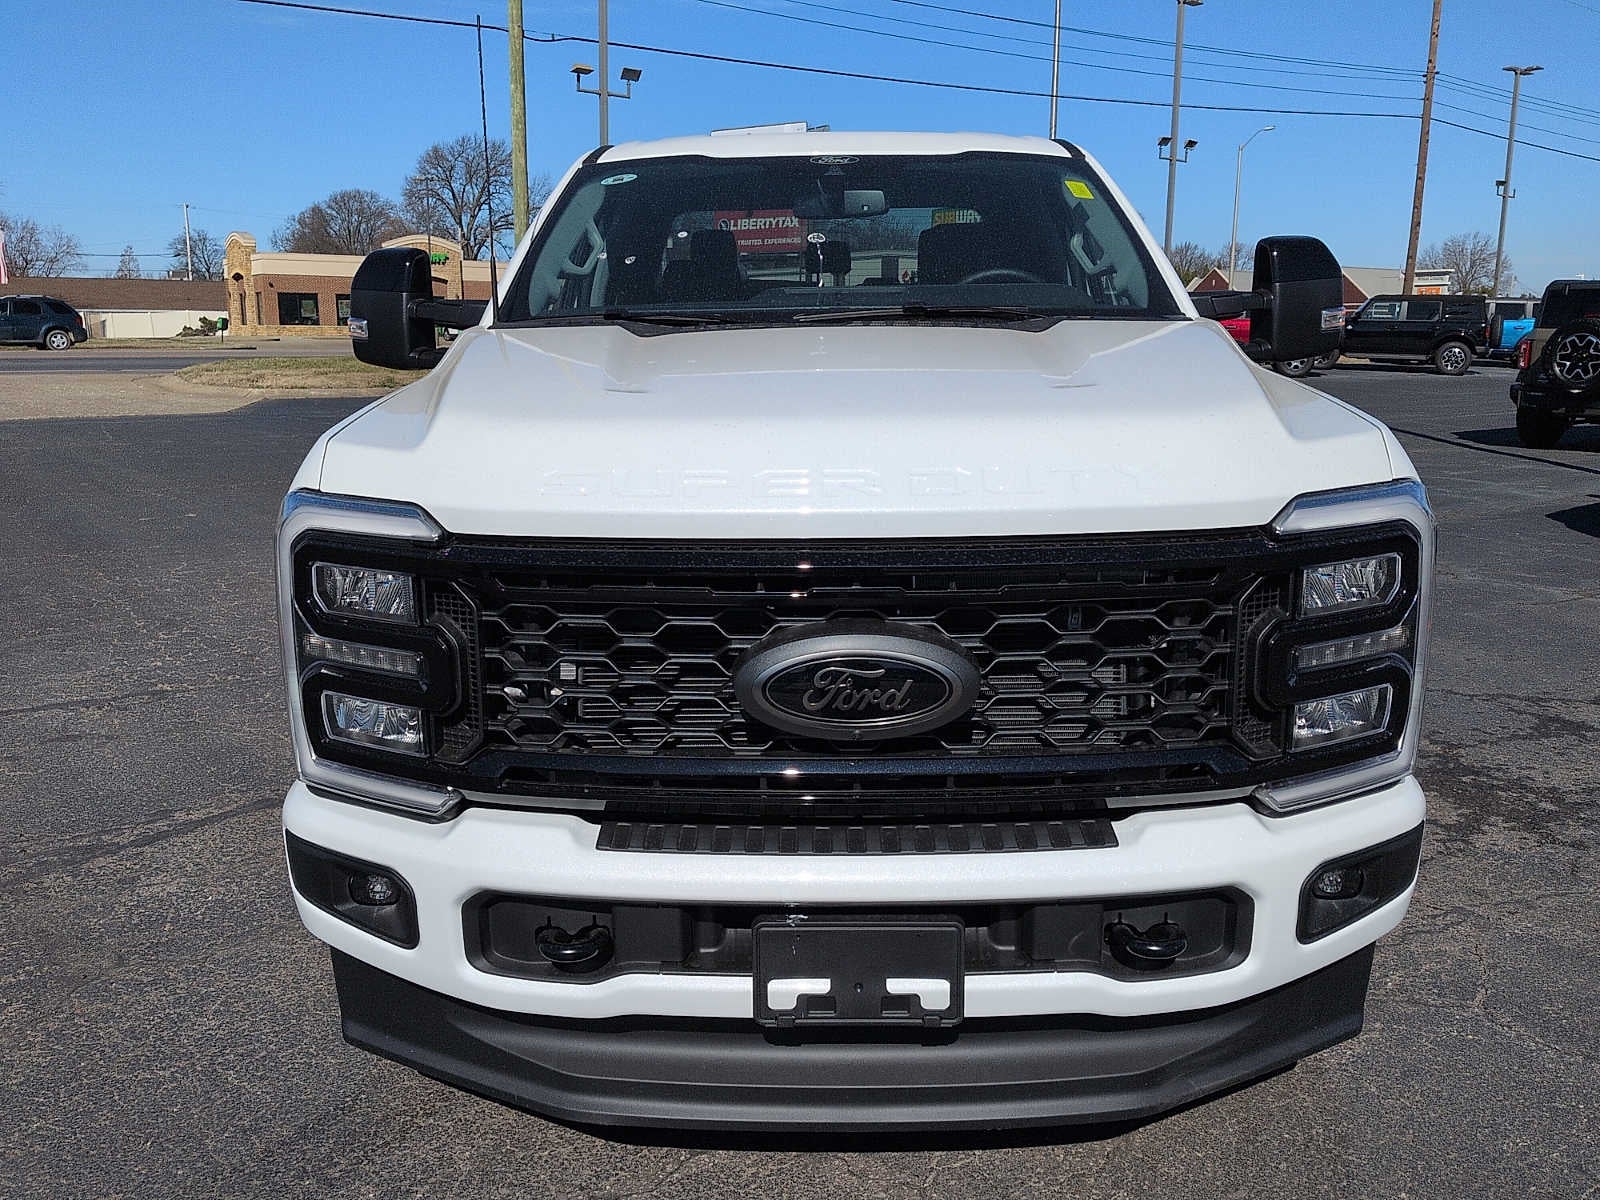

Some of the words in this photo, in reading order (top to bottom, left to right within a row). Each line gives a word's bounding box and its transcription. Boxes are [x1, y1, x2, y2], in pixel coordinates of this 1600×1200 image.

[934, 209, 981, 225] SUBWAY
[536, 467, 881, 498] SUPER
[907, 463, 1156, 496] DUTY
[803, 666, 914, 711] Ford
